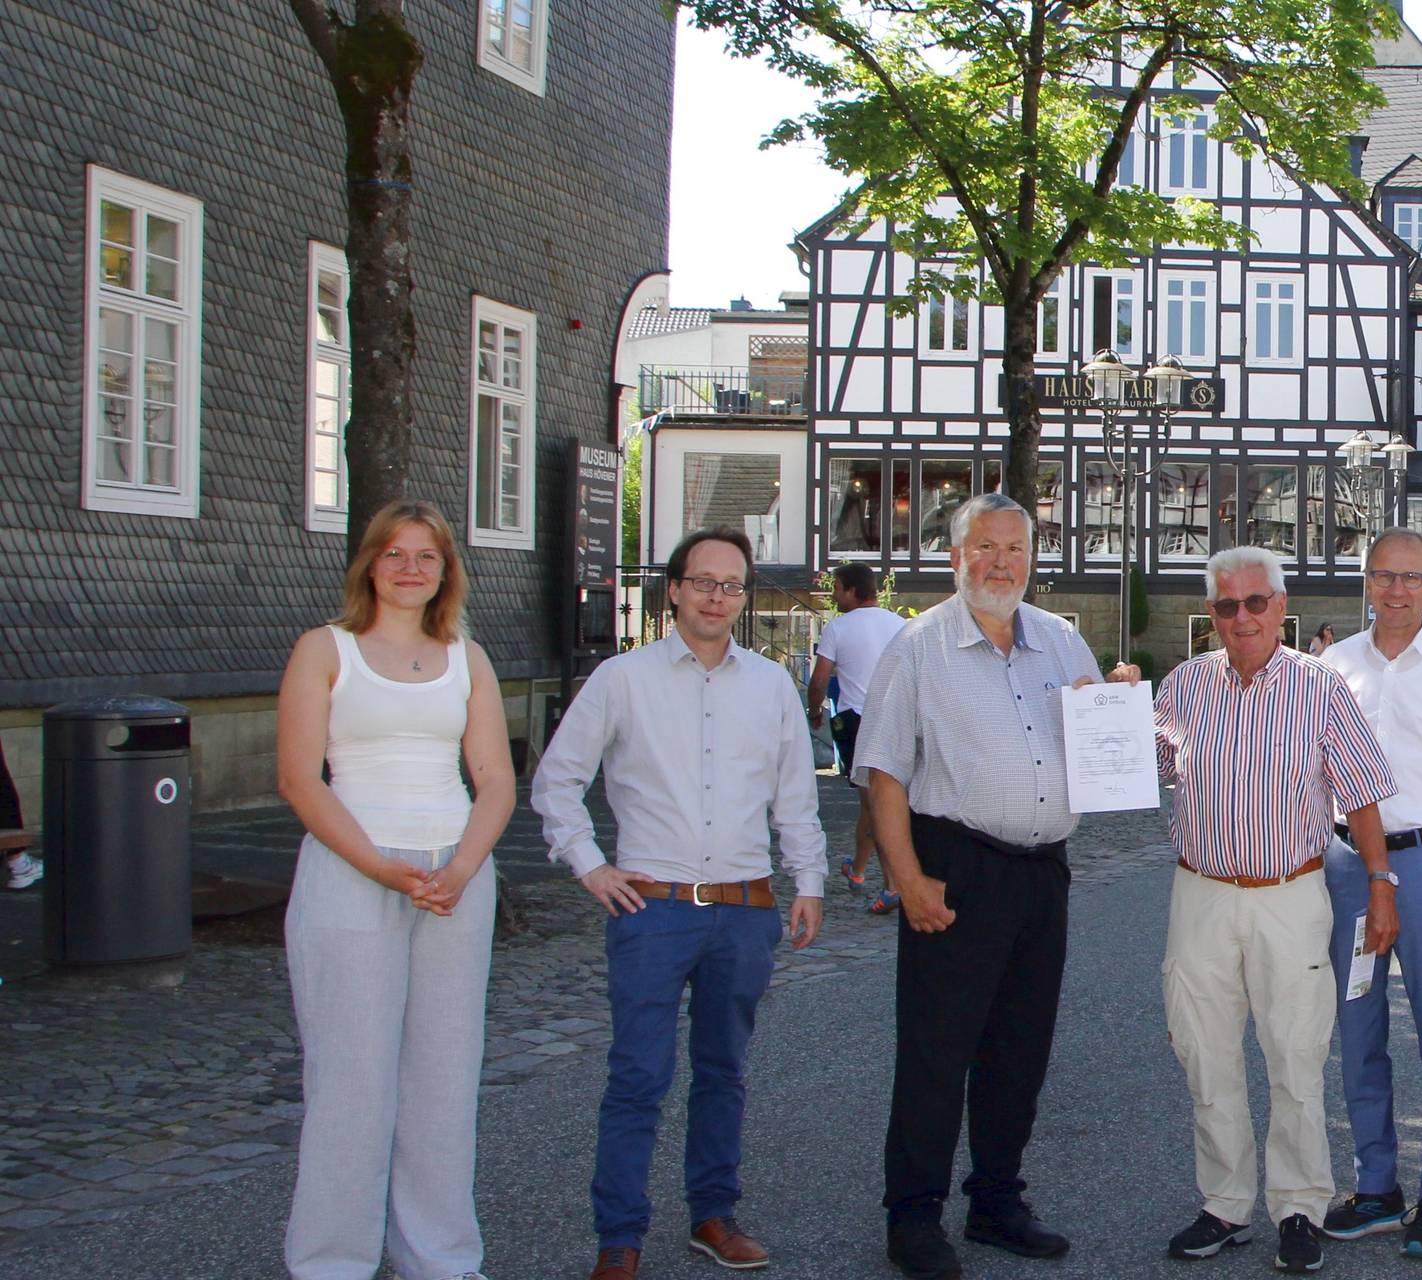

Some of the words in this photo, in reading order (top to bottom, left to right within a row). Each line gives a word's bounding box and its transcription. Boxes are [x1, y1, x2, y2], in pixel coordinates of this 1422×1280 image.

[1045, 377, 1095, 397] HAUS
[1063, 399, 1092, 408] HOTEL
[580, 446, 617, 469] MUSEUM
